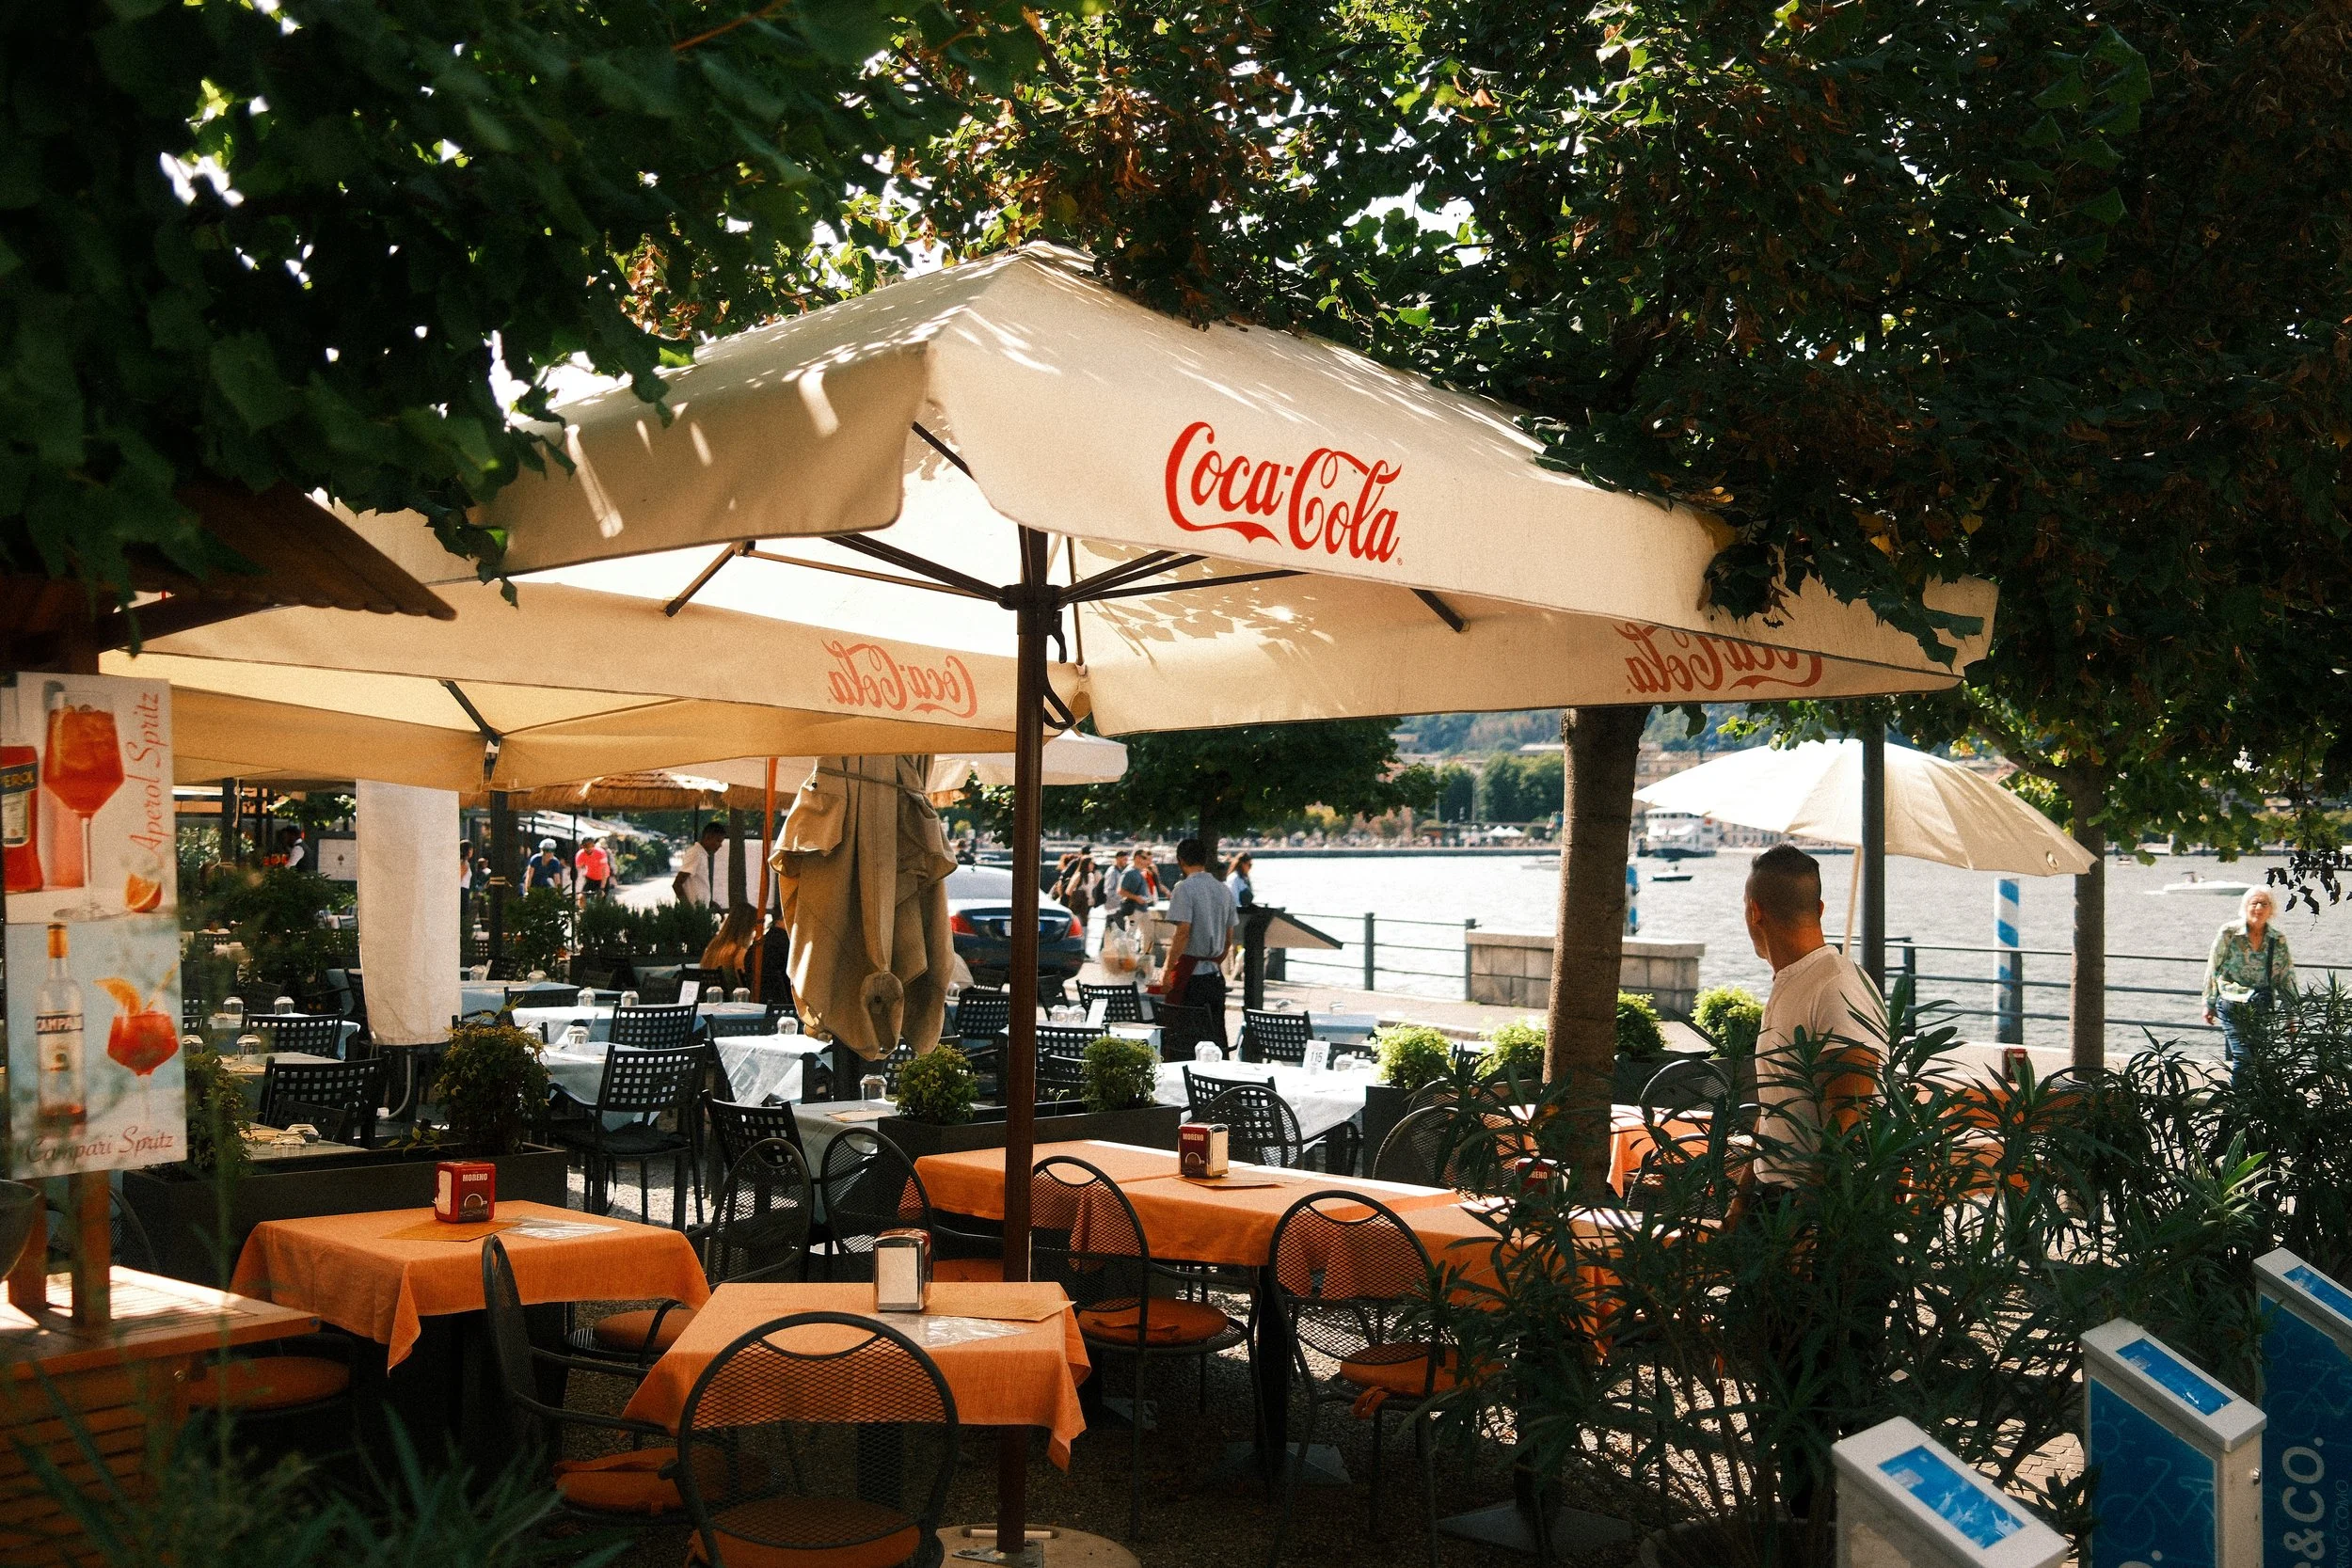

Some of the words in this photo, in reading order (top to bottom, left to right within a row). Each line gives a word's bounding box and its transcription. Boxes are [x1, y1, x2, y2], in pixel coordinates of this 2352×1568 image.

[1165, 421, 1403, 563] Coca-Cola
[126, 691, 169, 768] Spritz
[0, 769, 35, 788] EROL
[127, 773, 170, 868] Aperol
[1310, 1051, 1324, 1063] 115
[119, 1126, 175, 1157] Spritz
[1182, 1132, 1204, 1142] MORENO
[462, 1173, 488, 1182] MORENO
[1528, 1170, 1548, 1180] RENO
[2281, 1436, 2326, 1568] &CO.
[2335, 1480, 2350, 1531] COMO
